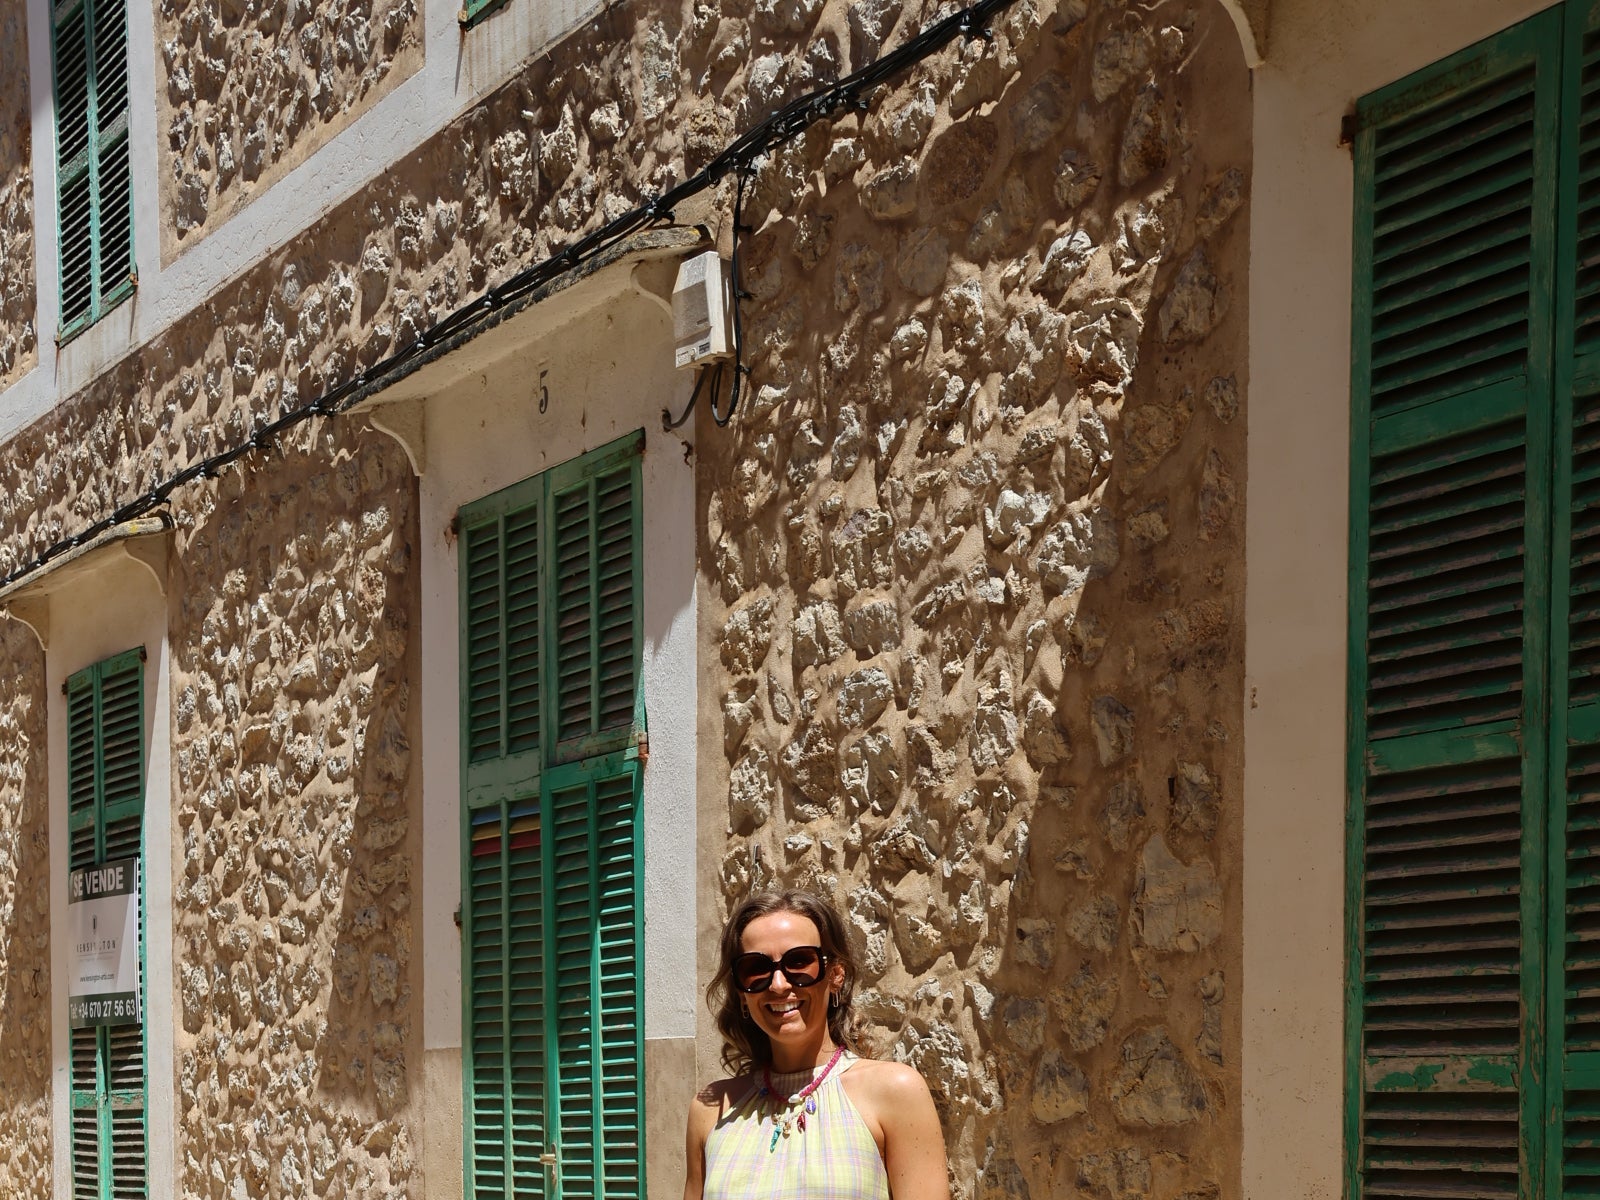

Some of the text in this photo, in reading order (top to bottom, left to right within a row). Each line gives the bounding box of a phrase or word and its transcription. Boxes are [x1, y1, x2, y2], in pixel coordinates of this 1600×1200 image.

[539, 369, 549, 415] 5
[73, 866, 124, 898] SE VENDE
[79, 1002, 89, 1018] +34
[89, 1001, 102, 1018] 670
[102, 1000, 113, 1017] 27
[114, 999, 124, 1017] 56
[125, 998, 136, 1016] 63
